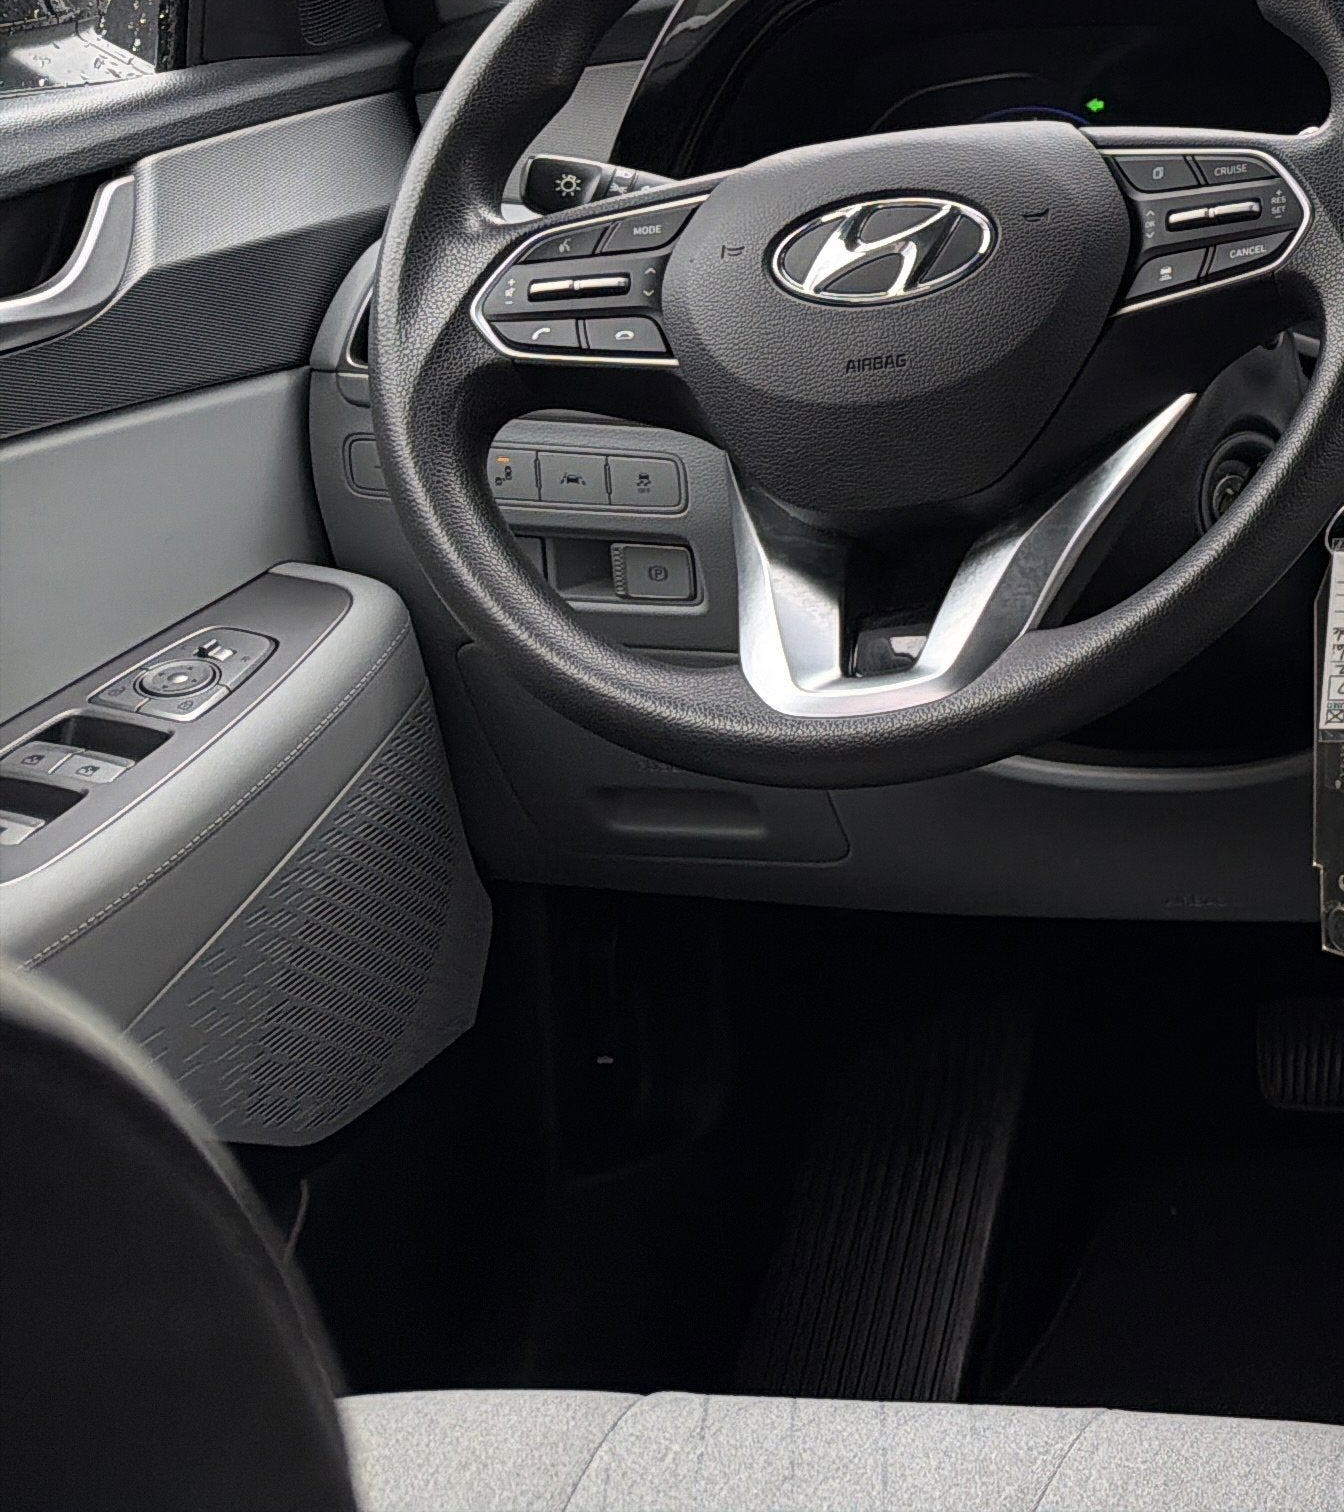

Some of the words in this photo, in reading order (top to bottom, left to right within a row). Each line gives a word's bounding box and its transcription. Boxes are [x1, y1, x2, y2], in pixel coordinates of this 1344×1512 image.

[1214, 163, 1248, 177] CRUISE
[1271, 195, 1286, 204] RES
[1271, 205, 1286, 214] SET
[633, 224, 662, 235] MODE
[1229, 244, 1267, 258] CANCEL
[845, 353, 909, 374] AIRBAG
